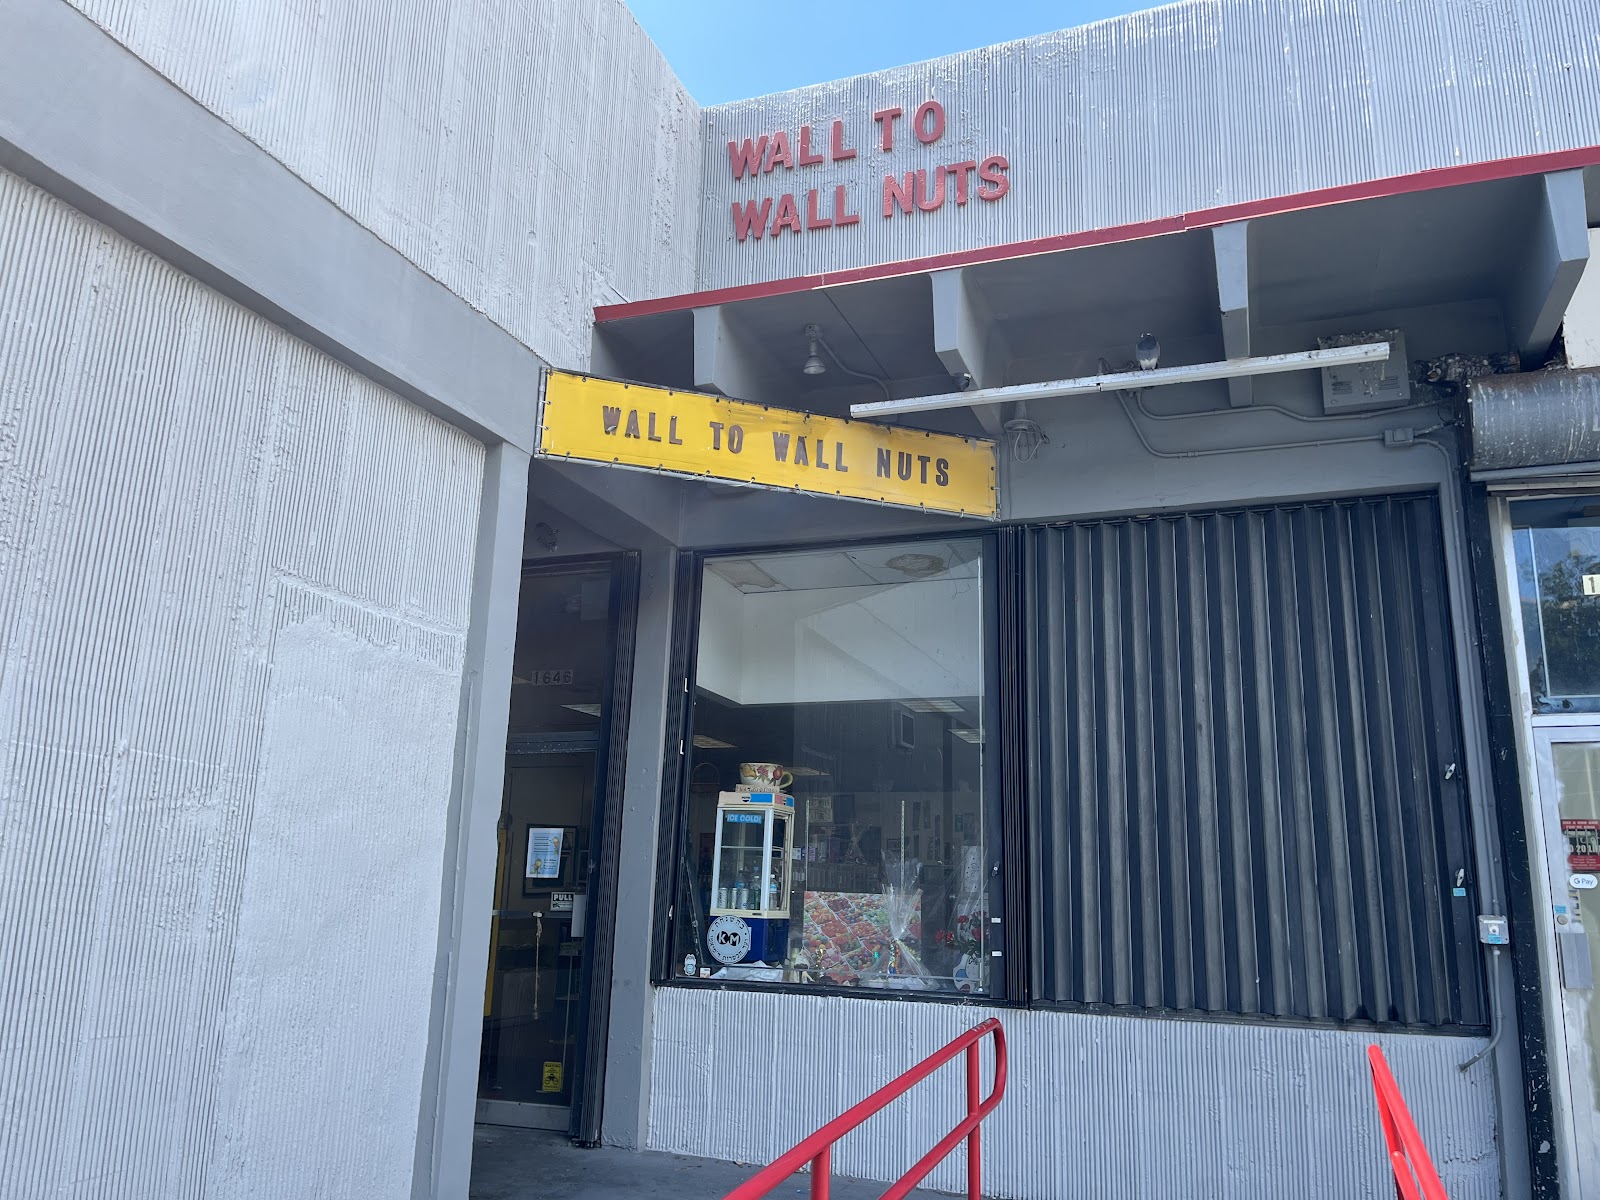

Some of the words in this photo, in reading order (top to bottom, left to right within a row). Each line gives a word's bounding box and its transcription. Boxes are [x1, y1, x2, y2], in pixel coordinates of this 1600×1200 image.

[728, 119, 857, 180] WALL
[873, 100, 946, 152] TO
[731, 184, 860, 242] WALL
[883, 155, 1010, 218] NUTS
[602, 405, 683, 445] WALL
[709, 421, 744, 454] TO
[773, 431, 848, 473] WALL
[876, 447, 949, 487] NUTS
[534, 671, 571, 685] 1646
[1575, 844, 1587, 853] 20
[1581, 878, 1594, 886] Pay
